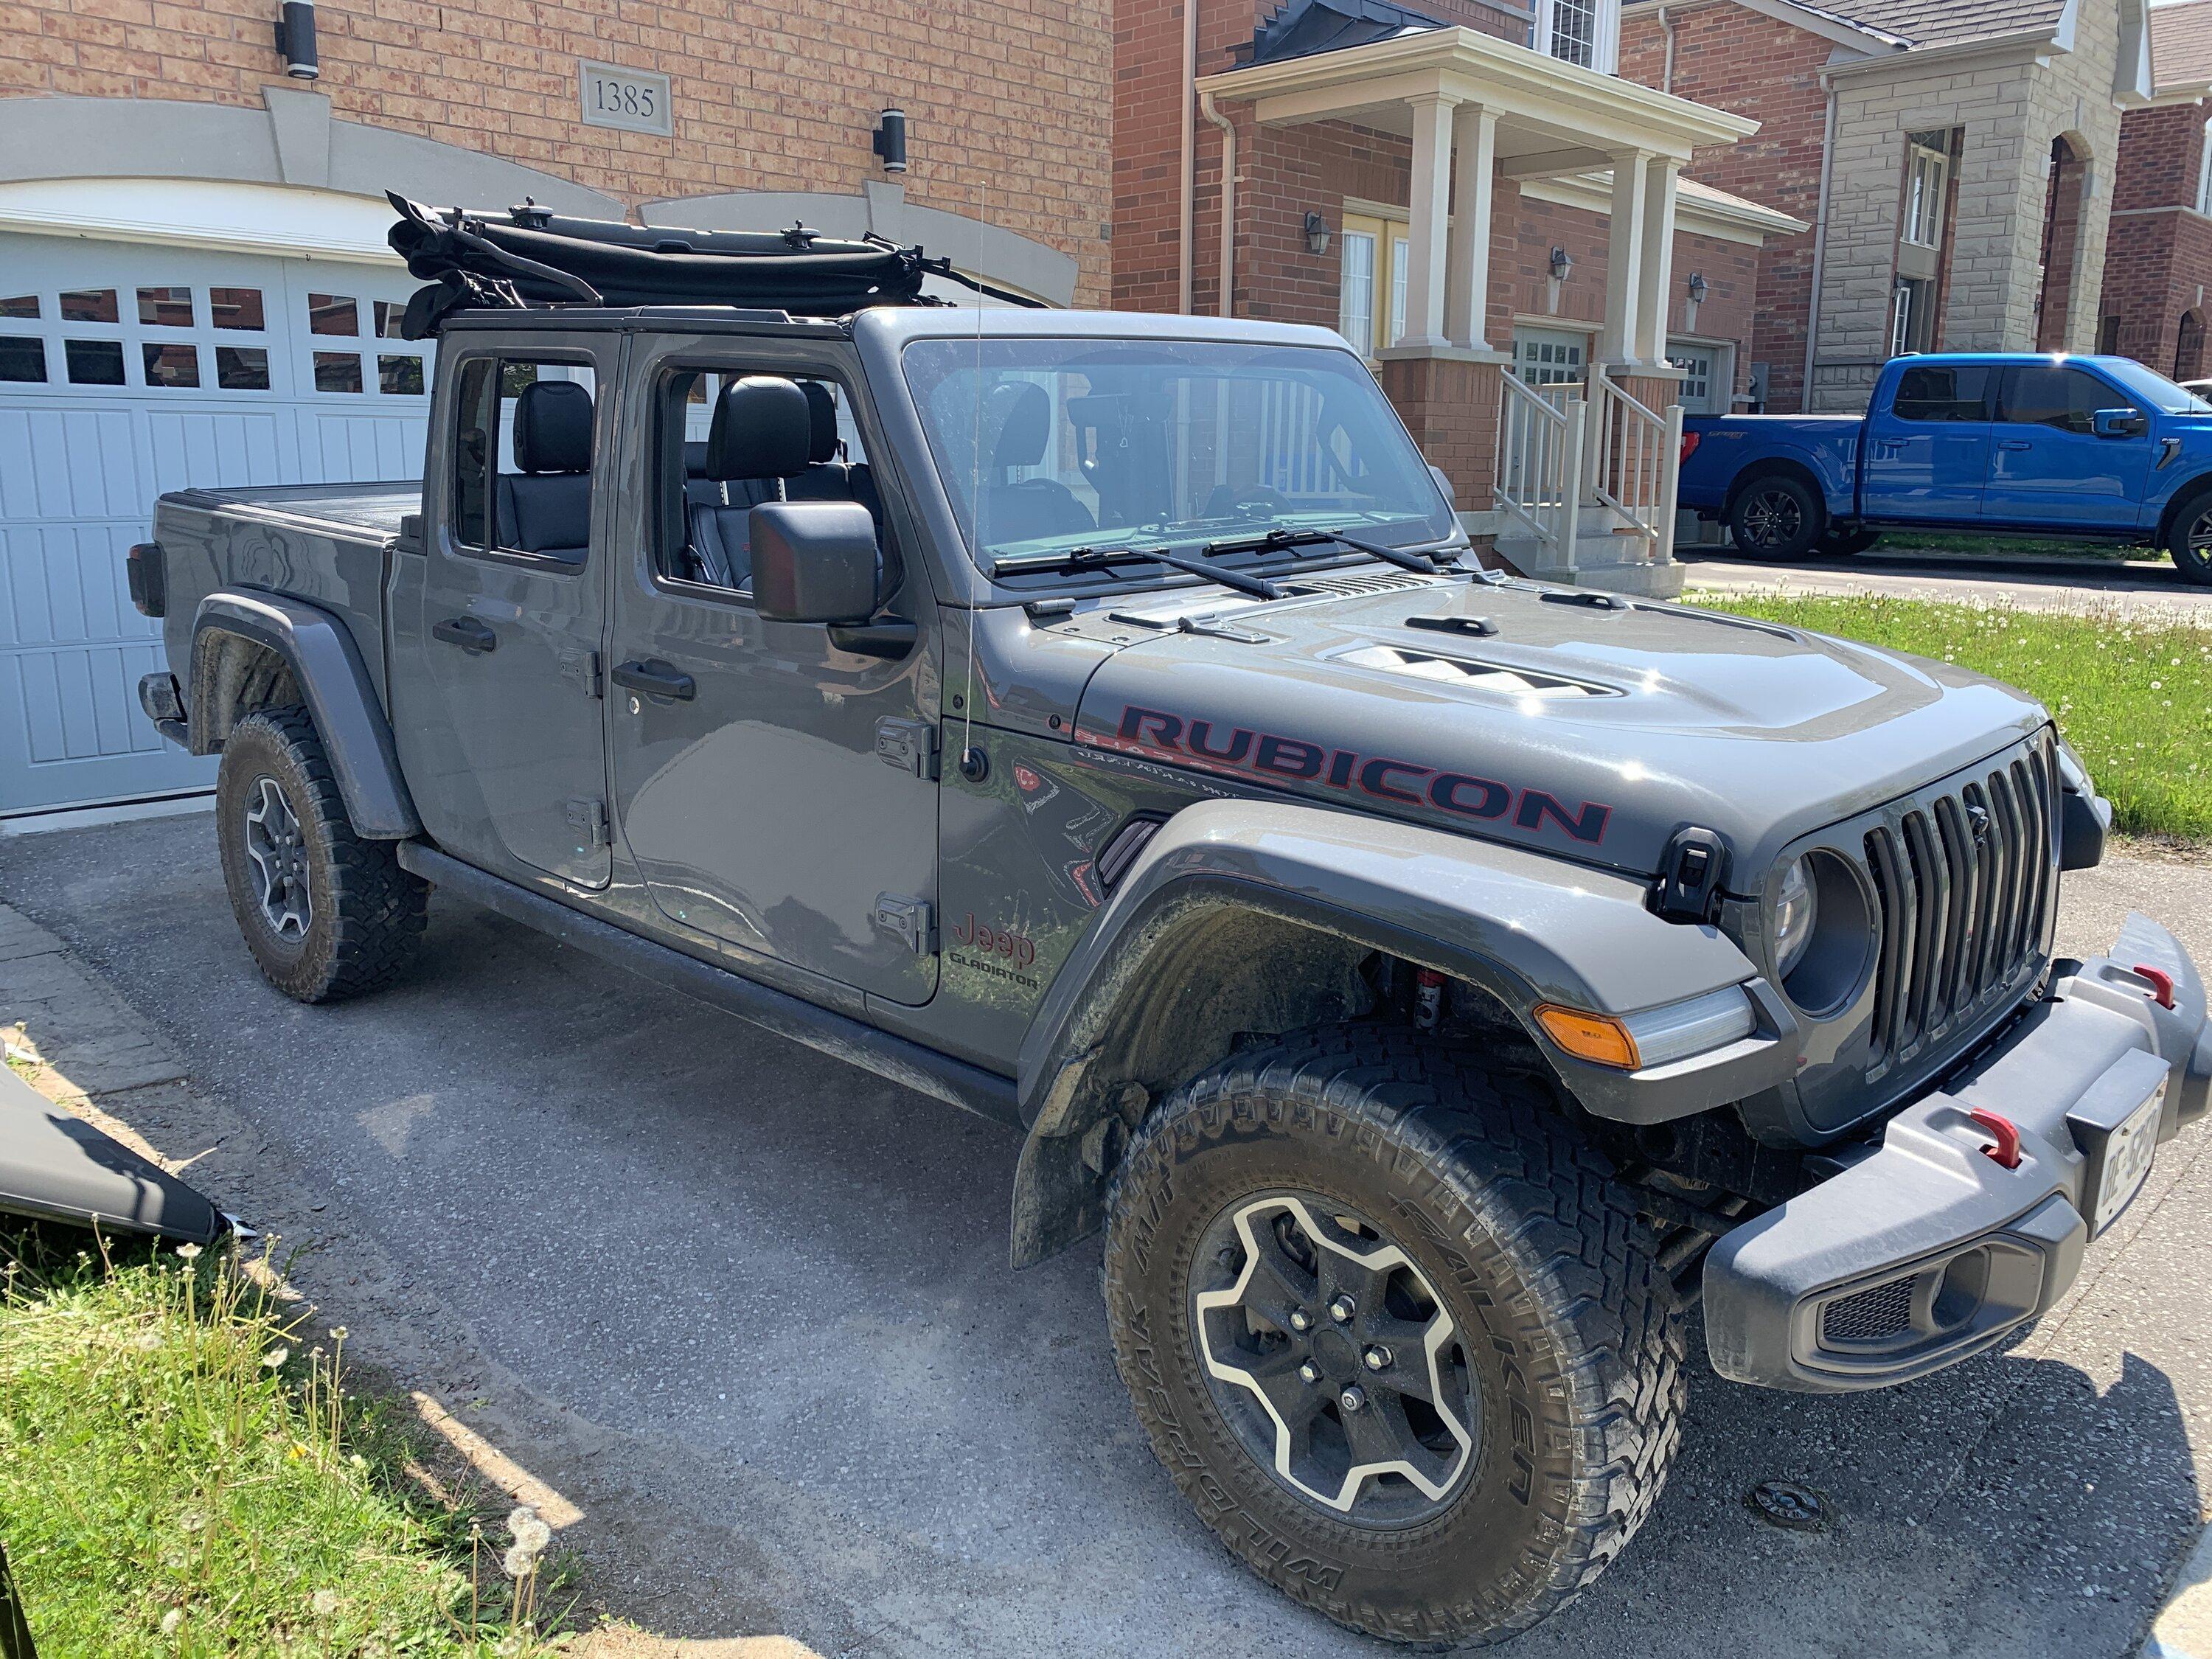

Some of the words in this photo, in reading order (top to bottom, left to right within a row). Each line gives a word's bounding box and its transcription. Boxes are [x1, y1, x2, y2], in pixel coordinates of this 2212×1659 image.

[596, 80, 654, 117] 1385
[1116, 705, 1613, 846] RUBICON
[953, 911, 1034, 970] Jeep
[950, 952, 1038, 990] GLADIATOR
[1128, 1293, 1344, 1590] WILDPEAK
